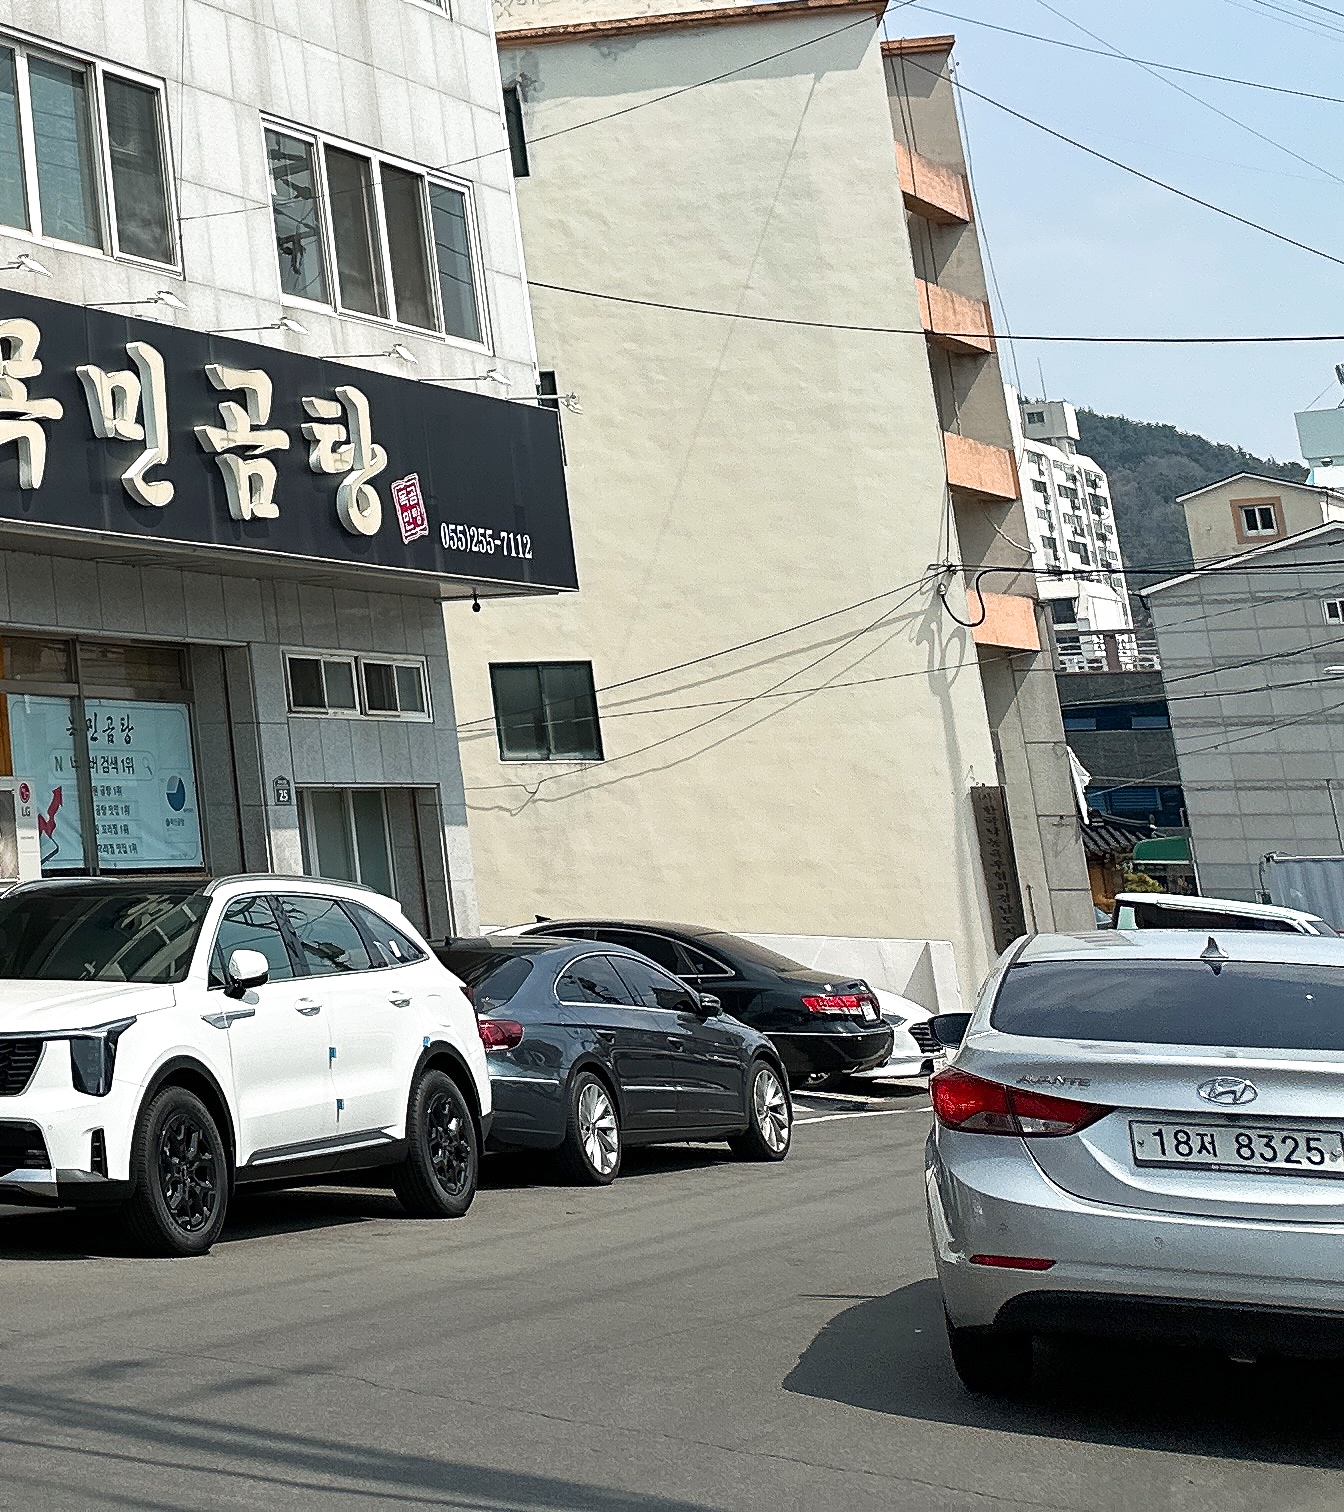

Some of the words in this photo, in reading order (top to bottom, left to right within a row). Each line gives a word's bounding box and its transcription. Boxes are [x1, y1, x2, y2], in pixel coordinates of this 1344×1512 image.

[440, 522, 532, 559] 055)255-7112
[21, 806, 30, 816] LG
[1152, 1126, 1218, 1159] 18저
[1234, 1131, 1326, 1166] 8325
